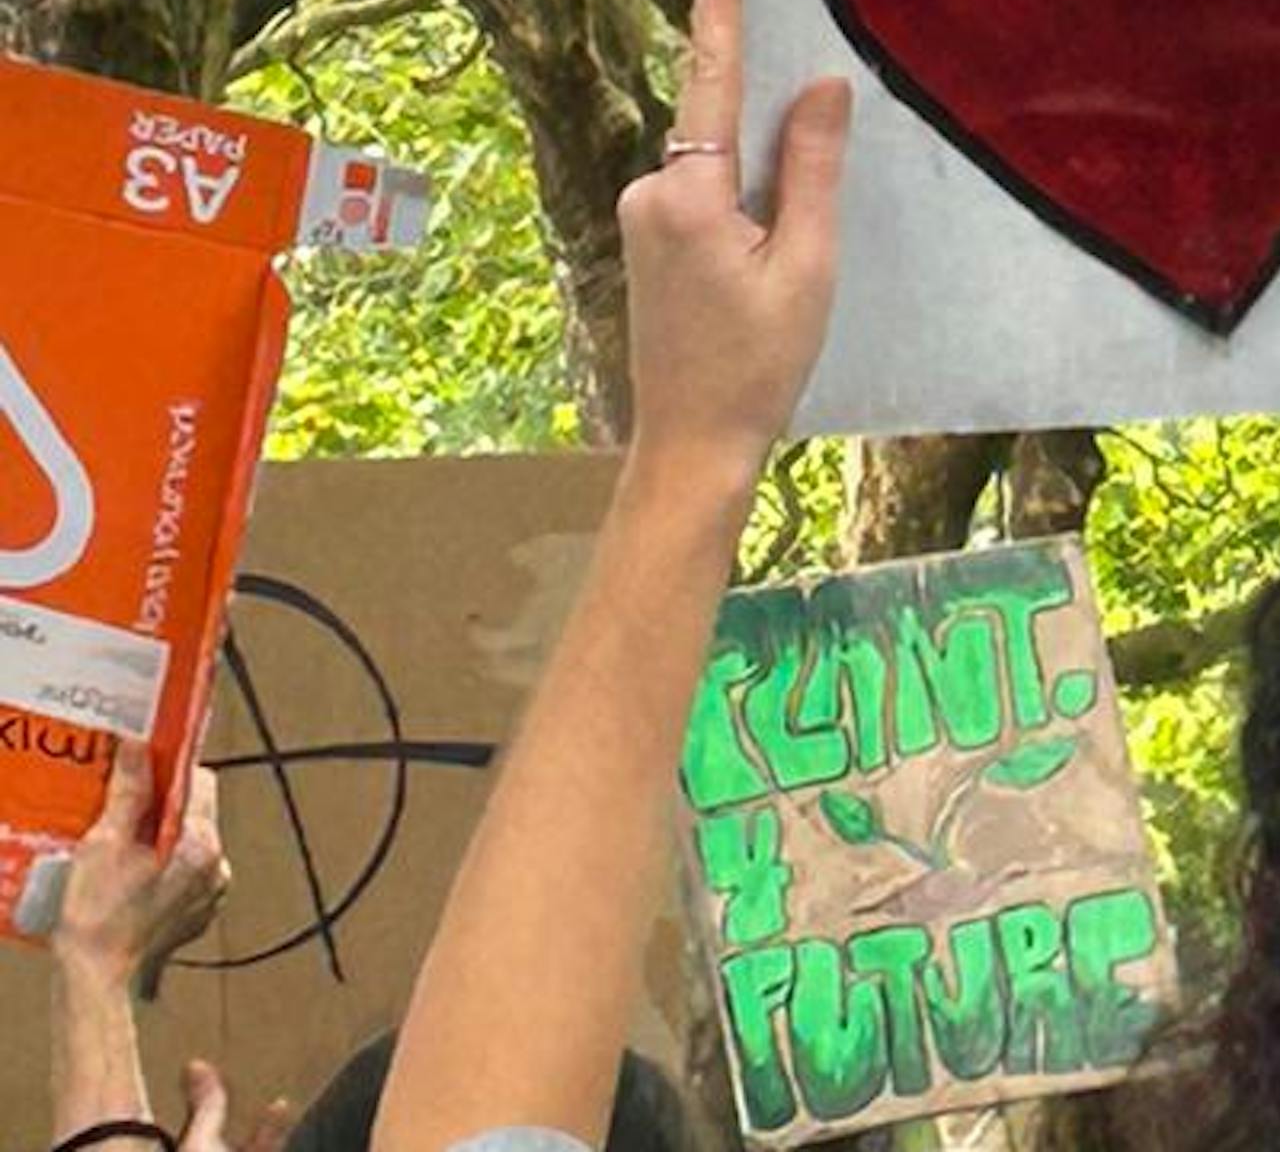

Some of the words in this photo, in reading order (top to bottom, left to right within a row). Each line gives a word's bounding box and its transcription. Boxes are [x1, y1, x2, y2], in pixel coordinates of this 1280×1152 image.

[128, 109, 248, 160] PAPER
[121, 145, 241, 225] A3
[720, 886, 1160, 1132] FUTURE
